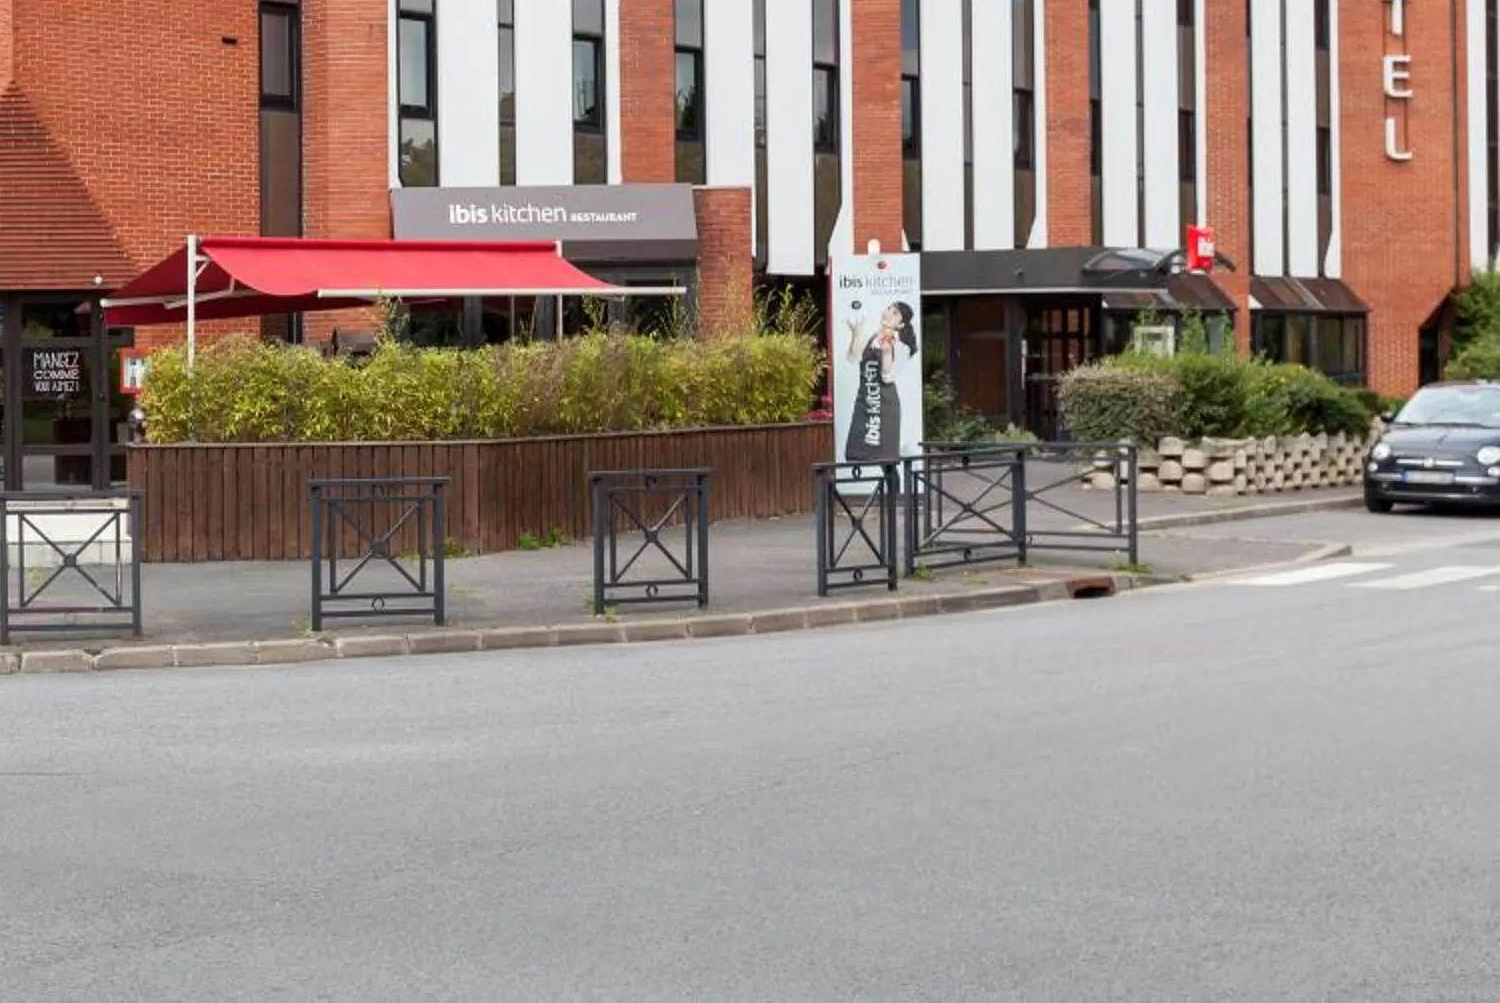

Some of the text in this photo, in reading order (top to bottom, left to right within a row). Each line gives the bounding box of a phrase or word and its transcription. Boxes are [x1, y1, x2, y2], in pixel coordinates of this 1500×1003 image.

[450, 203, 637, 224] ibis kitchen RESTAURANT
[840, 274, 914, 289] ibis kitchen
[33, 352, 79, 368] MANGEZ
[33, 369, 80, 380] COMME
[864, 360, 881, 446] ibis kitchen
